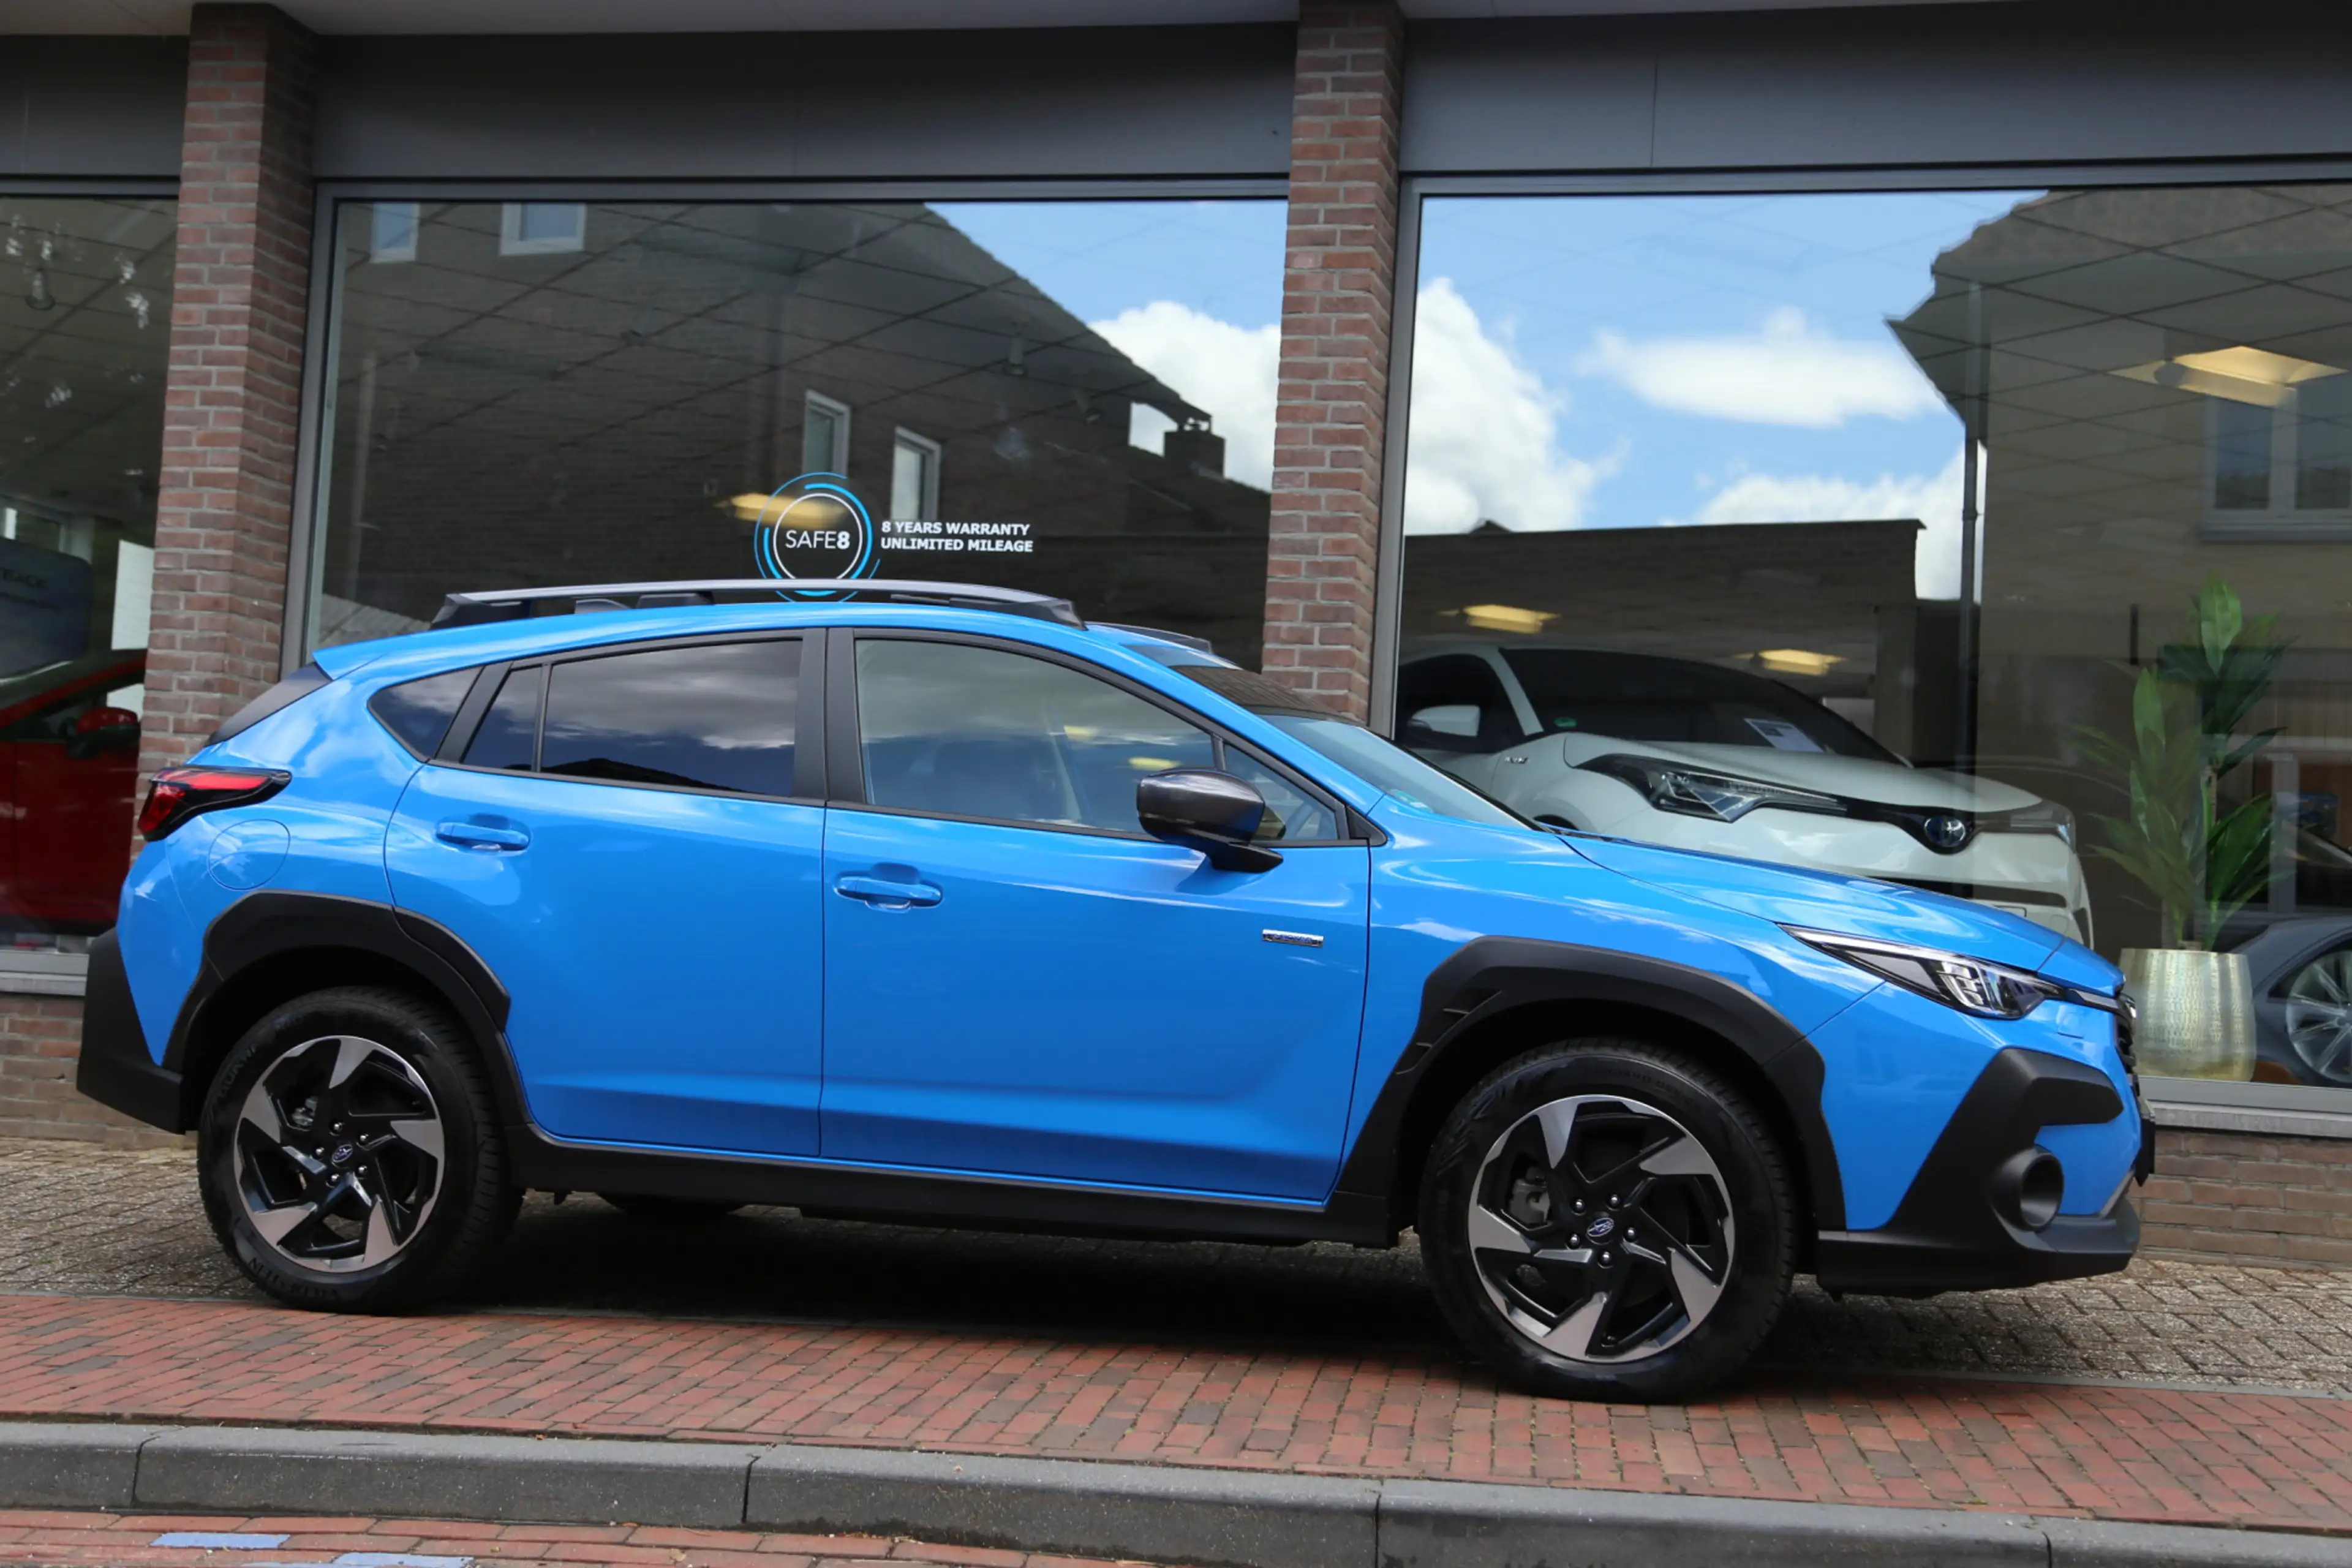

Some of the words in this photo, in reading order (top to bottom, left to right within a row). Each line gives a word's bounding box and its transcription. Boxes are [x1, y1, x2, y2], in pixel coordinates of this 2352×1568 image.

[881, 522, 891, 533] 8
[895, 522, 942, 534] YEARS
[946, 523, 1030, 536] WARRANTY
[785, 530, 851, 550] SAFE8
[881, 537, 963, 551] UNLIMITED
[968, 539, 1033, 552] MILEAGE
